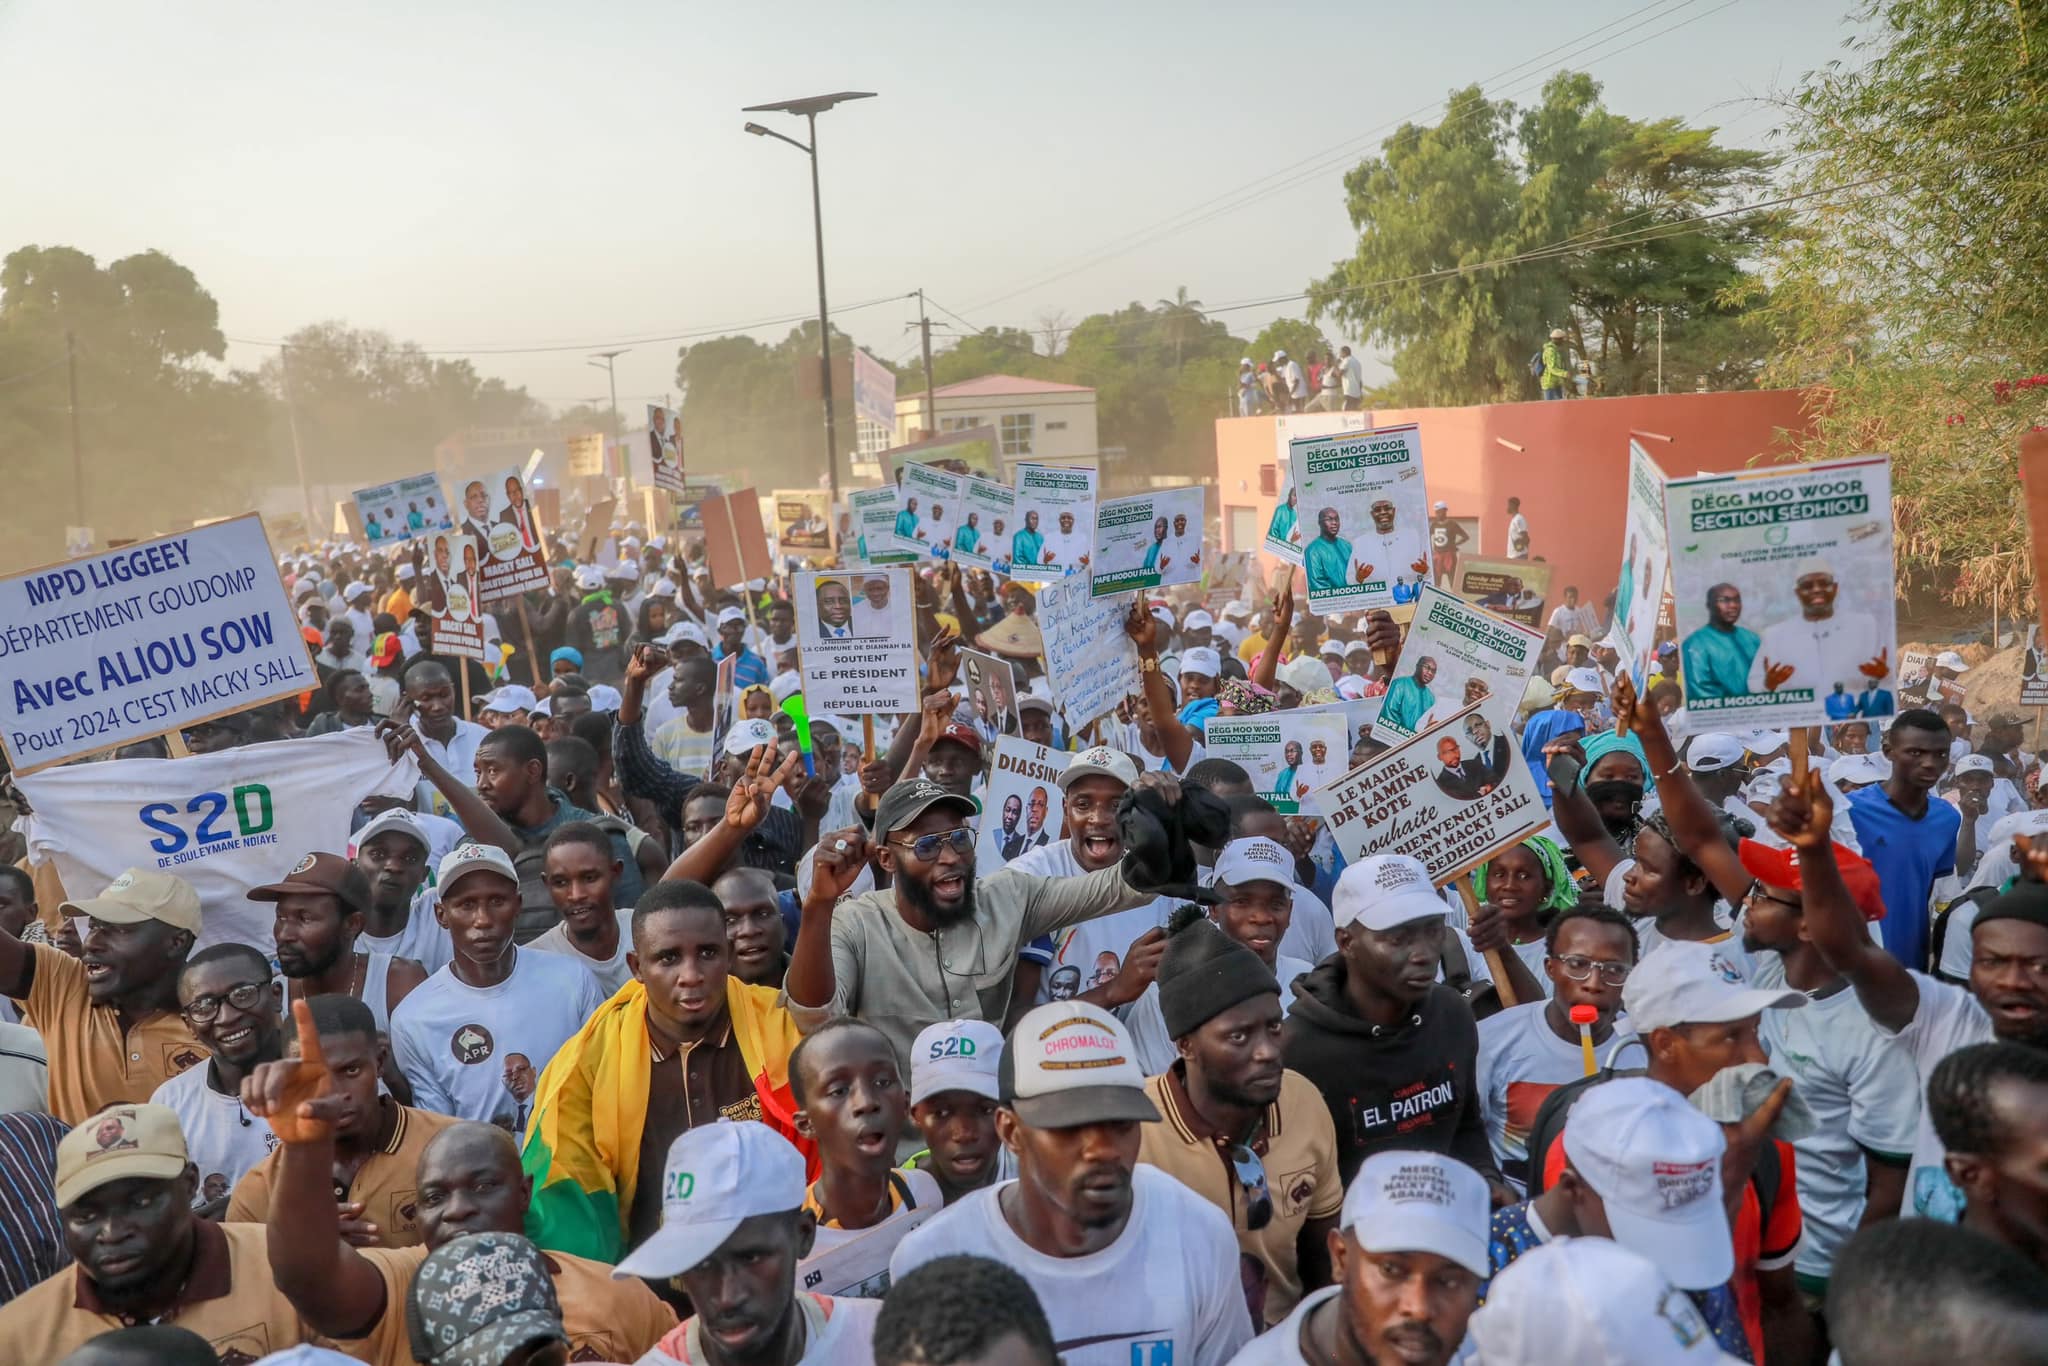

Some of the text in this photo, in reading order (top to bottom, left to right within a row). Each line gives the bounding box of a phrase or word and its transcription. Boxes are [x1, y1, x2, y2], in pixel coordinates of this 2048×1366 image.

[1341, 444, 1367, 456] MOO
[1369, 440, 1406, 452] WOOR
[1309, 461, 1356, 473] SECTION
[1748, 488, 1794, 505] MOO
[1798, 480, 1863, 498] WOOR
[1693, 496, 1867, 531] SECTION SÉDHIOU
[24, 538, 190, 607] MPD LIGGEEY
[148, 567, 256, 614] GOUDOMP
[1310, 583, 1385, 598] PAPE MODOU FALL
[1429, 612, 1475, 639] SECTION
[1465, 614, 1490, 632] MOO
[1493, 626, 1527, 648] WOOR
[13, 611, 274, 715] Avec ALIOU SOW
[811, 668, 908, 680] LE PRÉSIDENT
[834, 654, 888, 664] SOUTIENT
[12, 655, 304, 755] Pour 2024 C'EST MACKY SALL
[843, 686, 878, 694] DE LA
[1689, 690, 1812, 709] PAPE MODOU FALL
[1210, 736, 1244, 744] SECTION
[1253, 725, 1280, 733] WOOR
[998, 753, 1064, 785] DIASSIN
[1036, 746, 1047, 760] LE
[1270, 793, 1291, 801] FALL
[1331, 765, 1428, 828] DR LAMINE
[1336, 758, 1409, 805] LE MAIRE
[139, 784, 273, 854] S2D
[1362, 793, 1411, 829] KOTE
[1394, 785, 1512, 855] BIENVENUE AU
[1360, 806, 1438, 857] souhaite
[1413, 793, 1531, 863] ENT MACKY SALL
[158, 834, 278, 868] DE SOULEYMANE NDIAYE
[1426, 828, 1496, 874] SEDHIOU
[464, 1046, 490, 1062] APR
[930, 1036, 976, 1060] S2D
[721, 1100, 751, 1116] Benno
[1363, 1107, 1388, 1128] EL
[1390, 1080, 1453, 1120] PATRON
